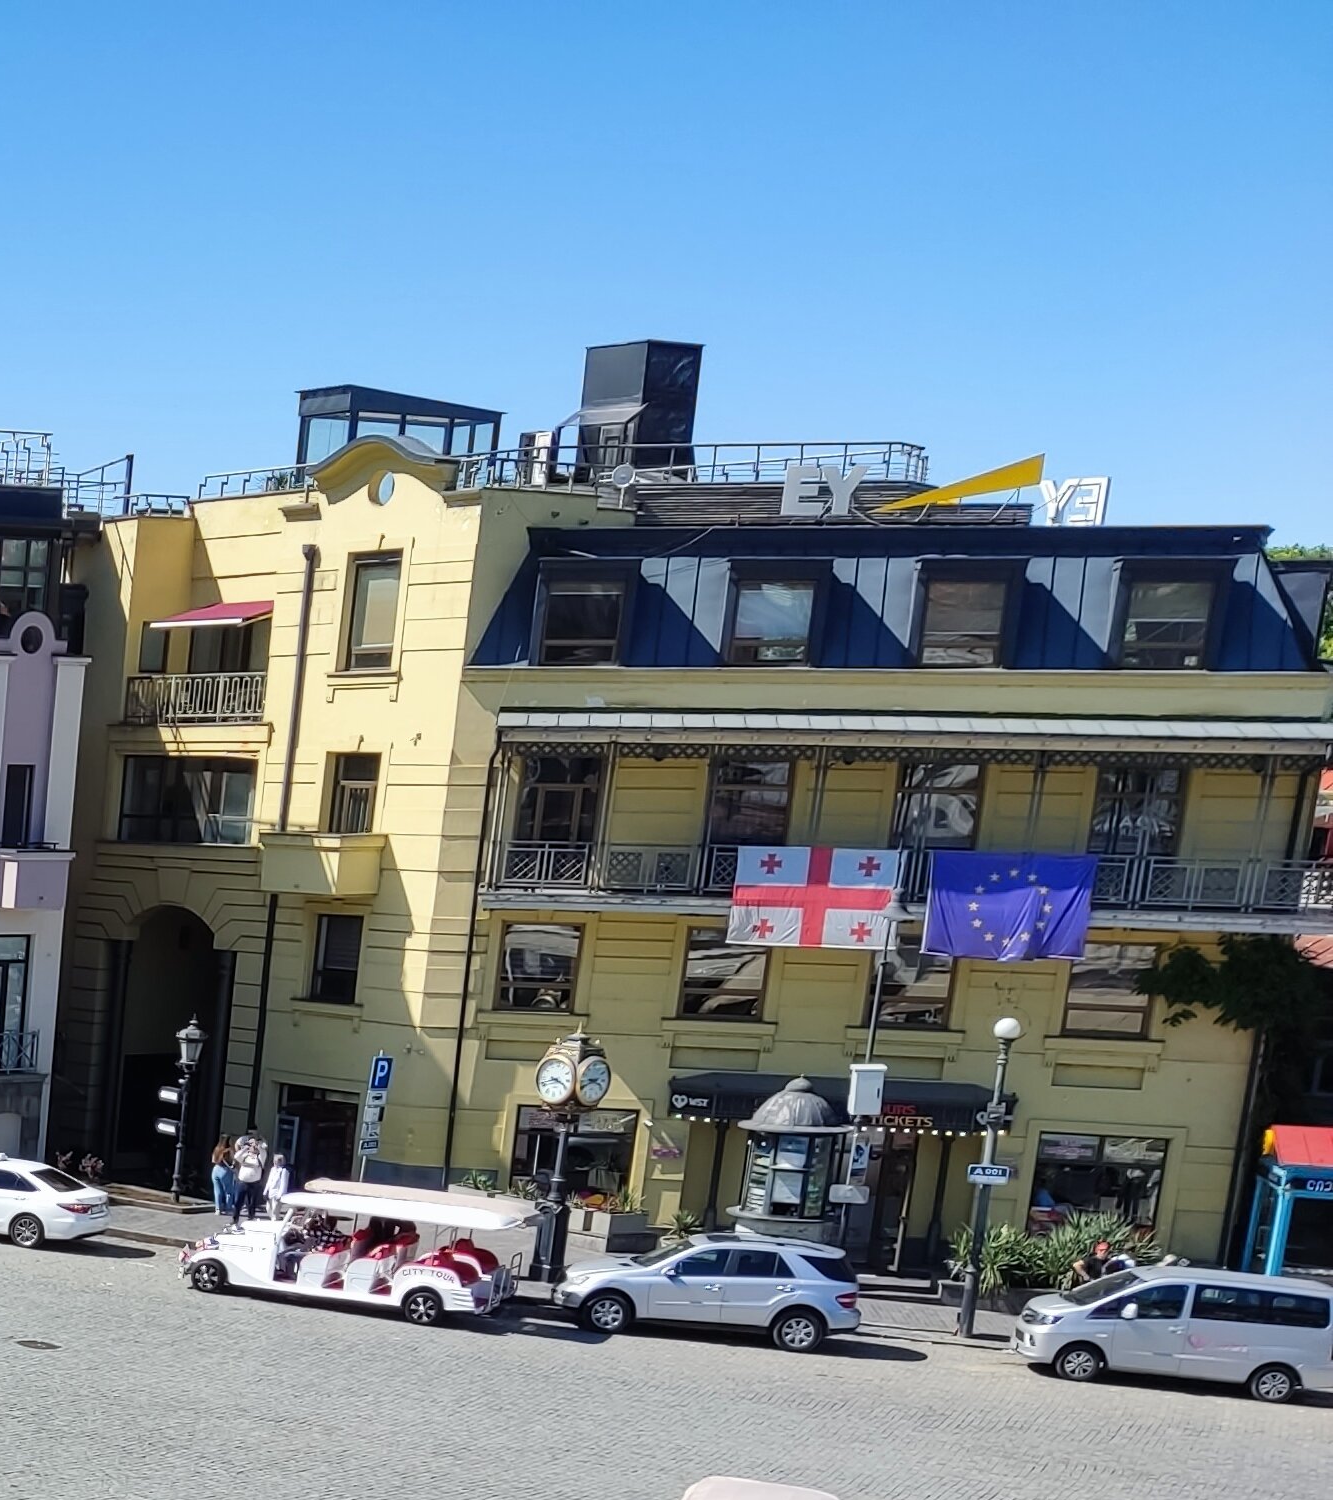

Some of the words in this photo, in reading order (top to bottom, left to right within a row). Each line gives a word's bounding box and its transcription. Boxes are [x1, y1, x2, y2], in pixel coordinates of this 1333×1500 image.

[780, 464, 868, 516] EY
[375, 1061, 388, 1086] P
[870, 1115, 933, 1127] TICKETS
[973, 1167, 983, 1175] A
[402, 1268, 424, 1277] CITY
[430, 1270, 455, 1284] TOUR
